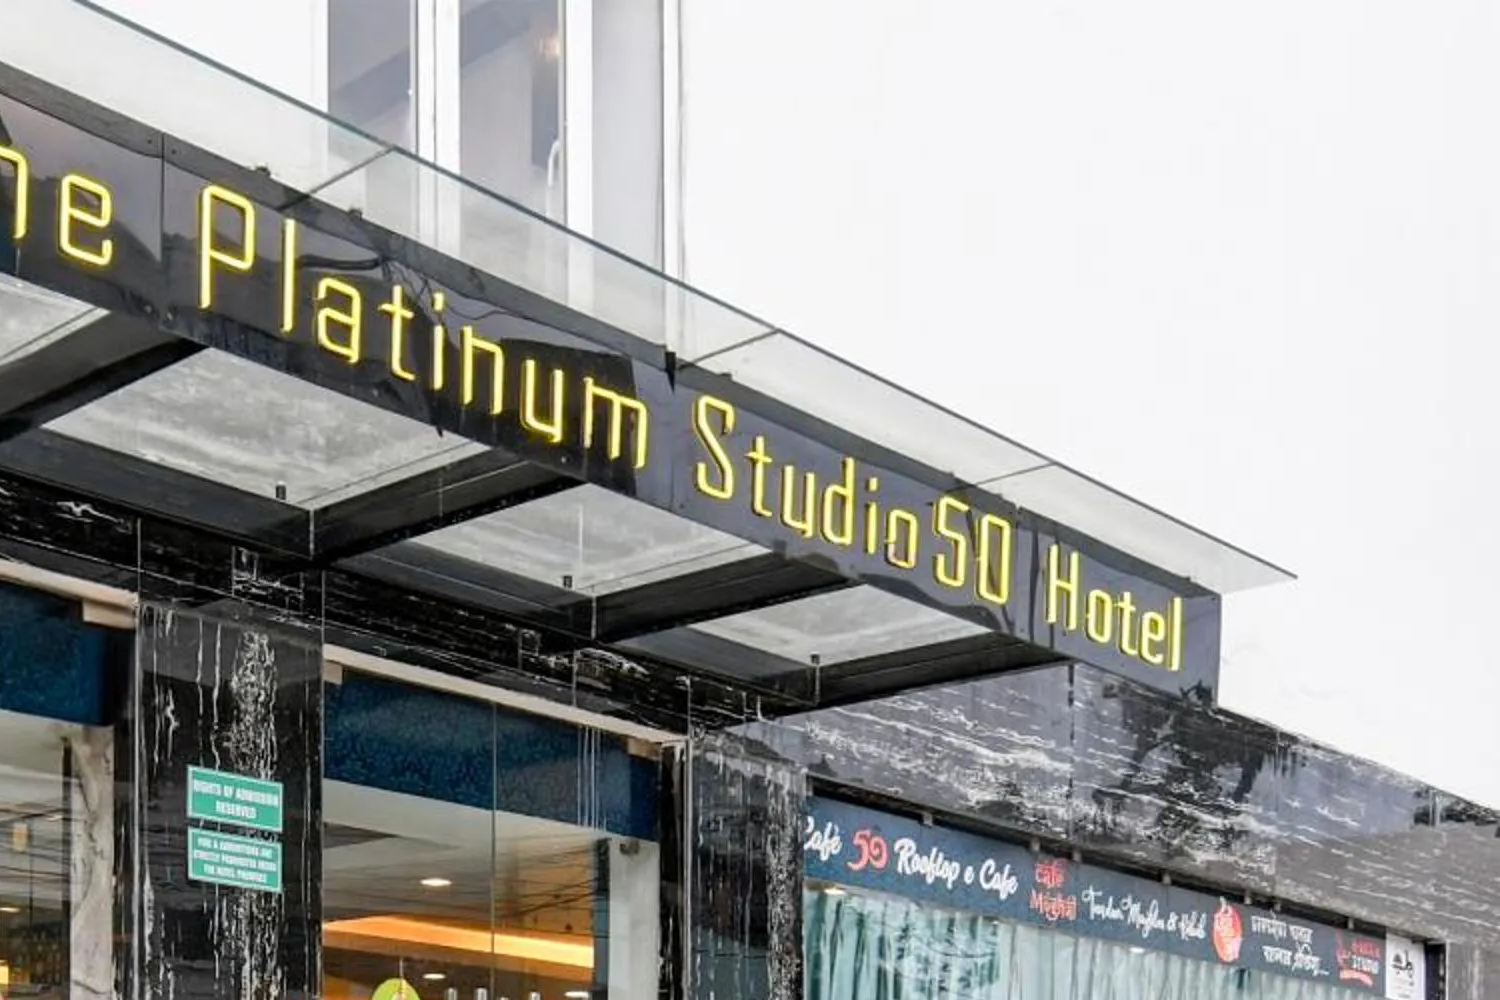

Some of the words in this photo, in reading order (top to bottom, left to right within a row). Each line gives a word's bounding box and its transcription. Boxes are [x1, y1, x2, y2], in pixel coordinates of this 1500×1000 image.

[199, 184, 650, 469] Platinum
[1044, 543, 1183, 672] Hotel
[893, 837, 960, 890] Rooftop
